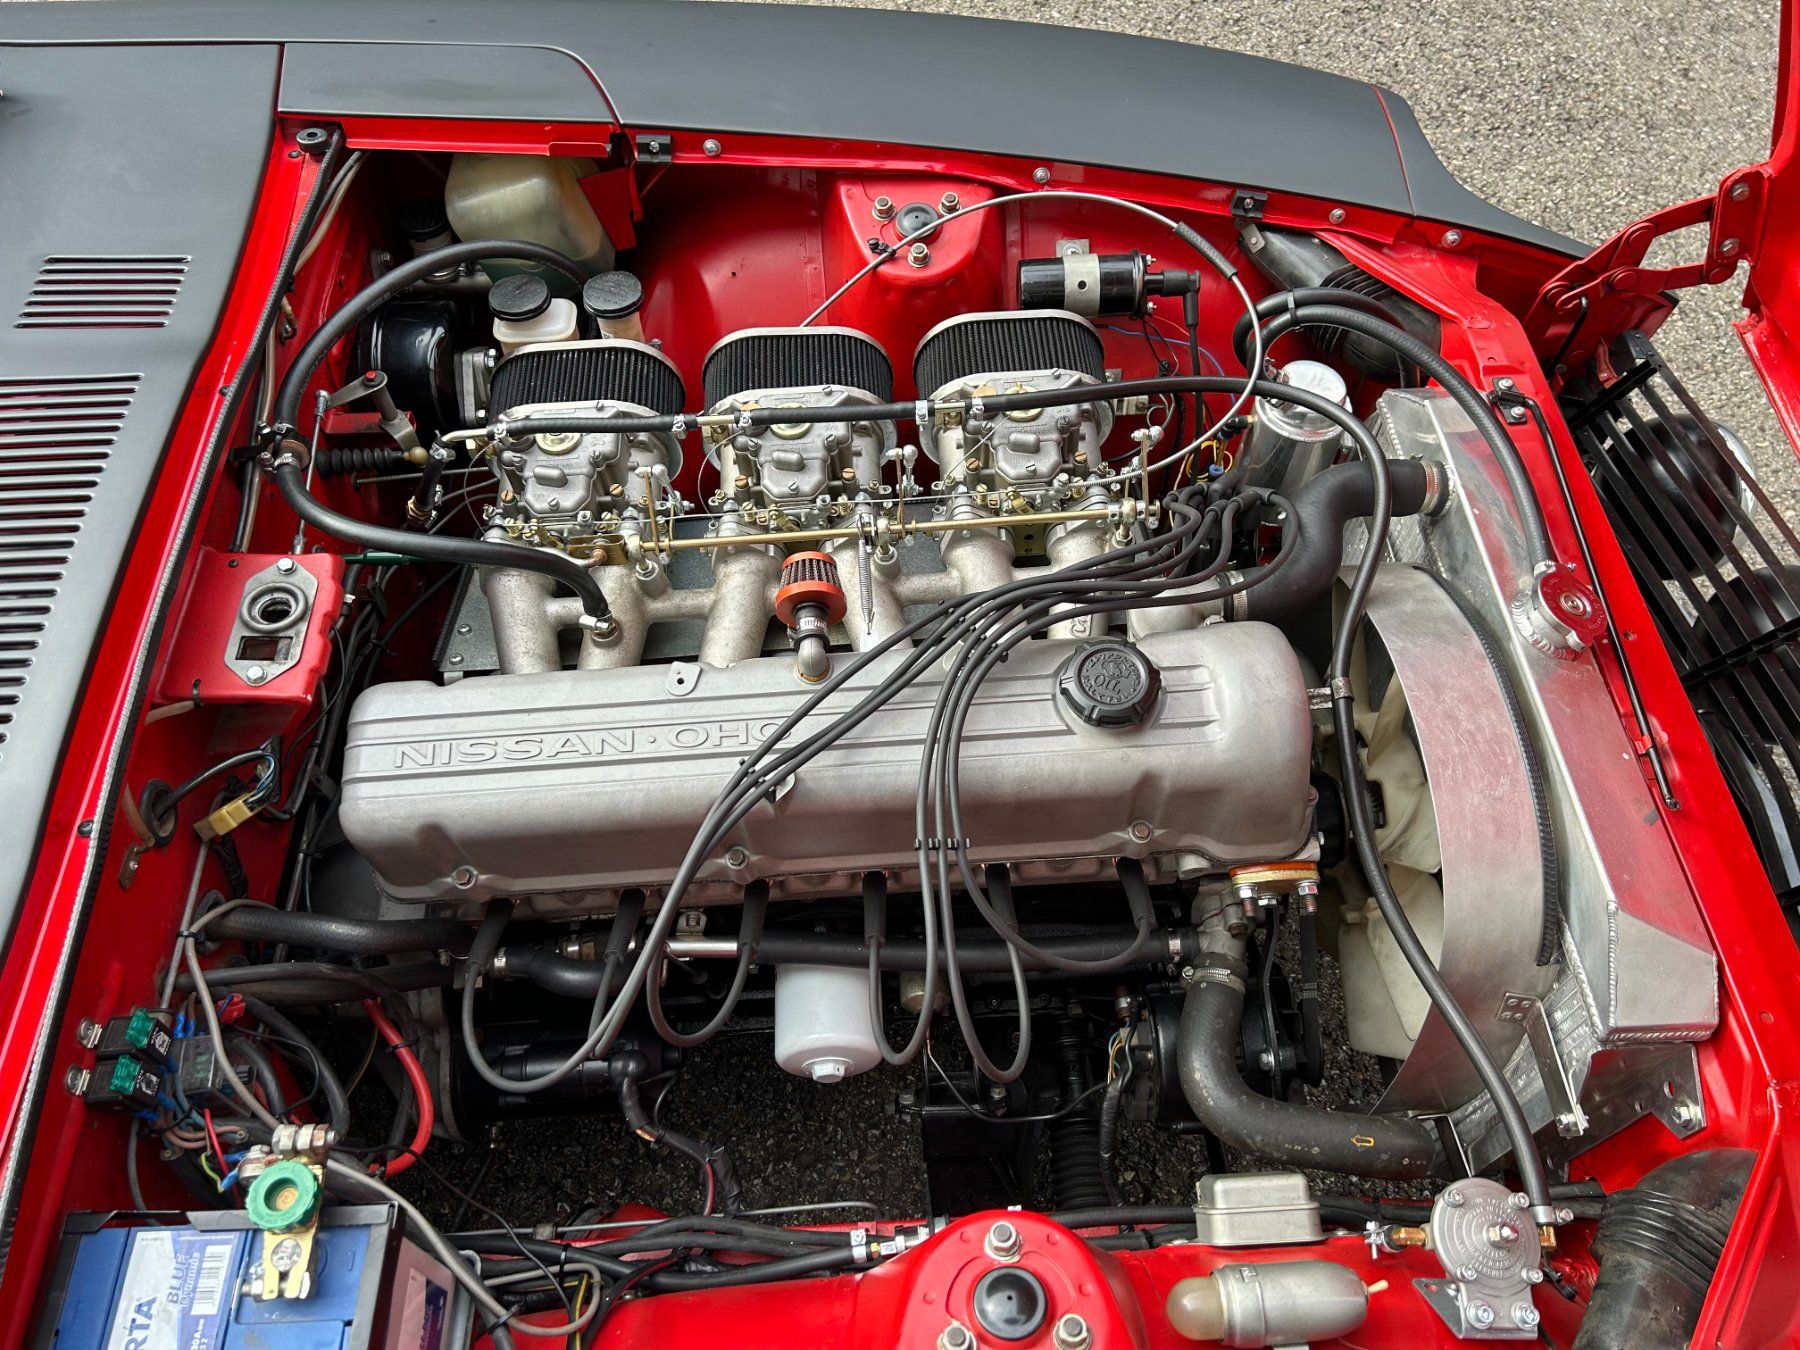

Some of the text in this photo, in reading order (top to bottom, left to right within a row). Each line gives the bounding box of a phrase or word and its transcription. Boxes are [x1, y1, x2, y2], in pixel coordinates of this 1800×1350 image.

[1094, 674, 1121, 695] OIL
[394, 729, 635, 768] NISSAN
[166, 1253, 190, 1304] BLUE
